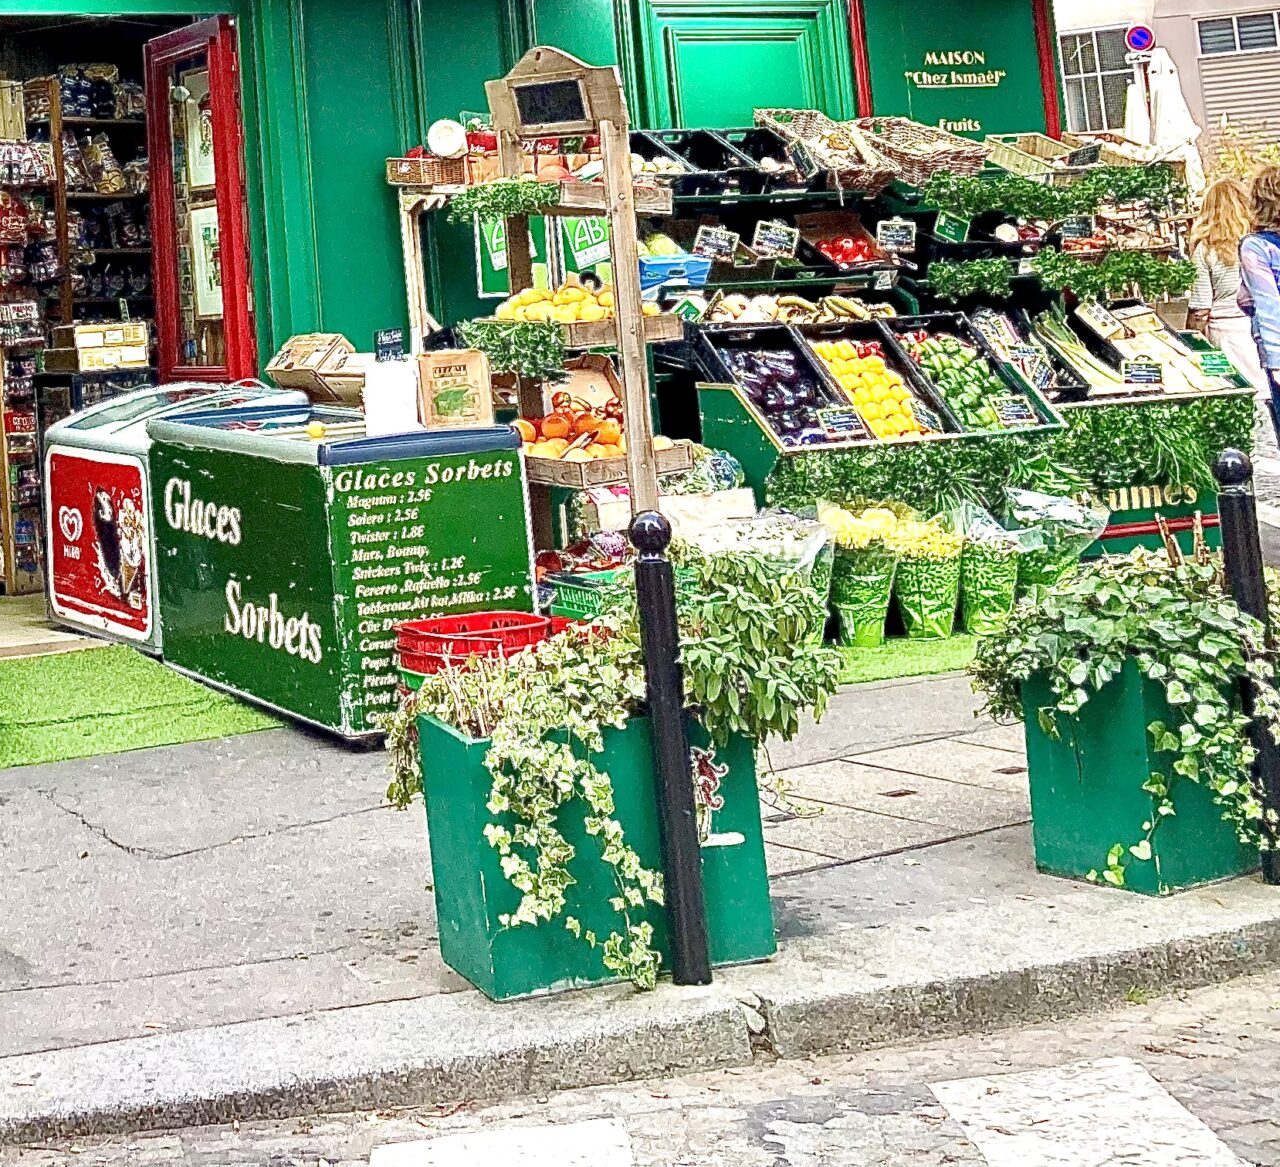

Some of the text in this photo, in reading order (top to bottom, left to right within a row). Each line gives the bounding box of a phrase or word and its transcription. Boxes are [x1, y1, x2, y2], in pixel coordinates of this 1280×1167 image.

[924, 51, 985, 66] MAISON
[939, 118, 981, 132] Fruits
[574, 216, 605, 251] AB
[335, 459, 513, 492] Glaces Sorbets
[164, 477, 242, 546] Glaces
[394, 507, 419, 522] 2.5€
[350, 530, 390, 544] Twister
[401, 525, 425, 539] 1.8€
[225, 579, 323, 664] Sorbets
